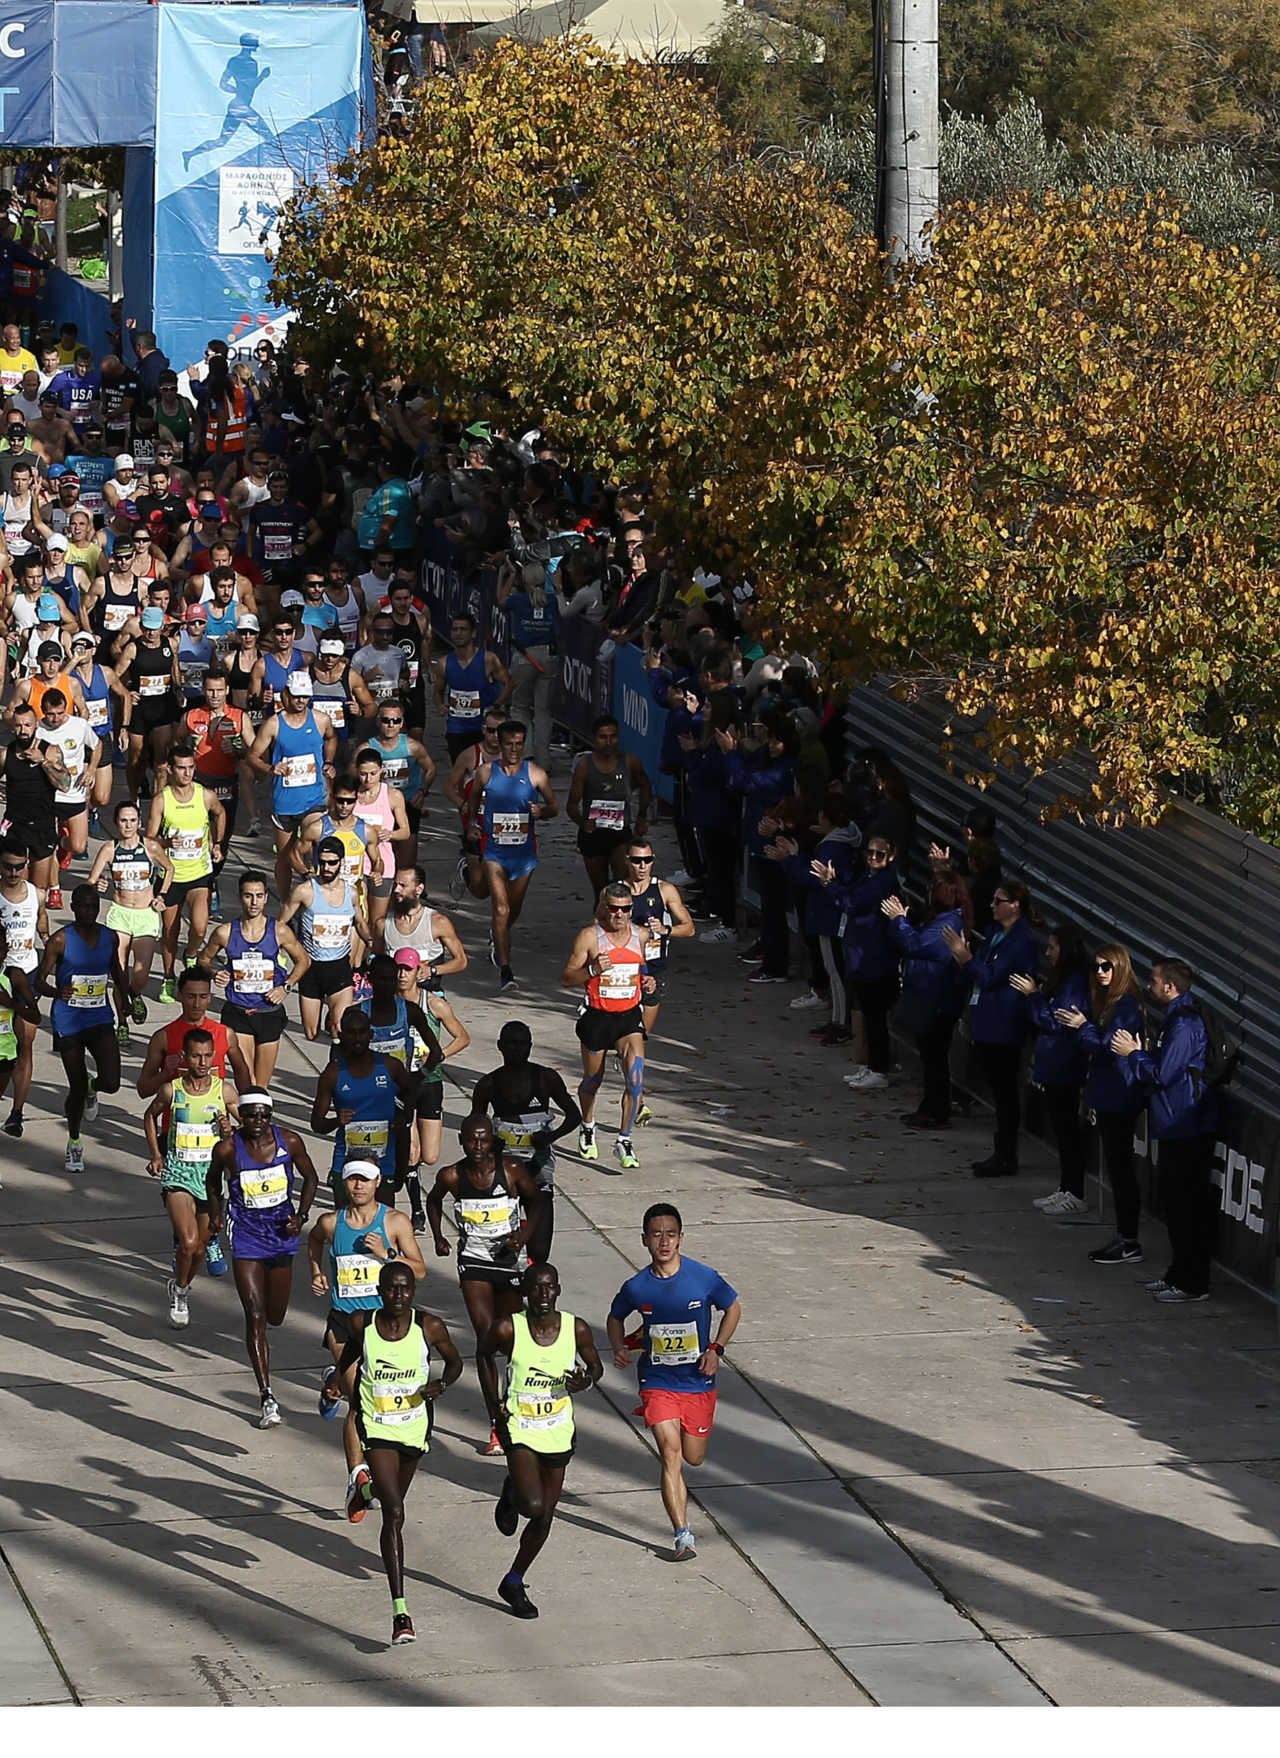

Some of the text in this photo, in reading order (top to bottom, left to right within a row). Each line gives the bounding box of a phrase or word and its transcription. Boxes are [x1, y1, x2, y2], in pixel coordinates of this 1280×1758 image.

[71, 389, 93, 401] USA
[623, 682, 649, 737] WIND
[501, 823, 521, 833] 222
[3, 920, 28, 930] WIND
[242, 971, 265, 982] 220
[86, 984, 95, 995] 8
[196, 1136, 201, 1147] 1
[363, 1133, 371, 1143] 4
[516, 1135, 523, 1145] 7
[261, 1181, 270, 1193] 6
[482, 1211, 490, 1222] 2
[354, 1267, 369, 1281] 21
[663, 1337, 685, 1350] 22
[374, 1369, 417, 1382] Rogelli
[394, 1396, 403, 1409] 9
[536, 1402, 552, 1416] 10
